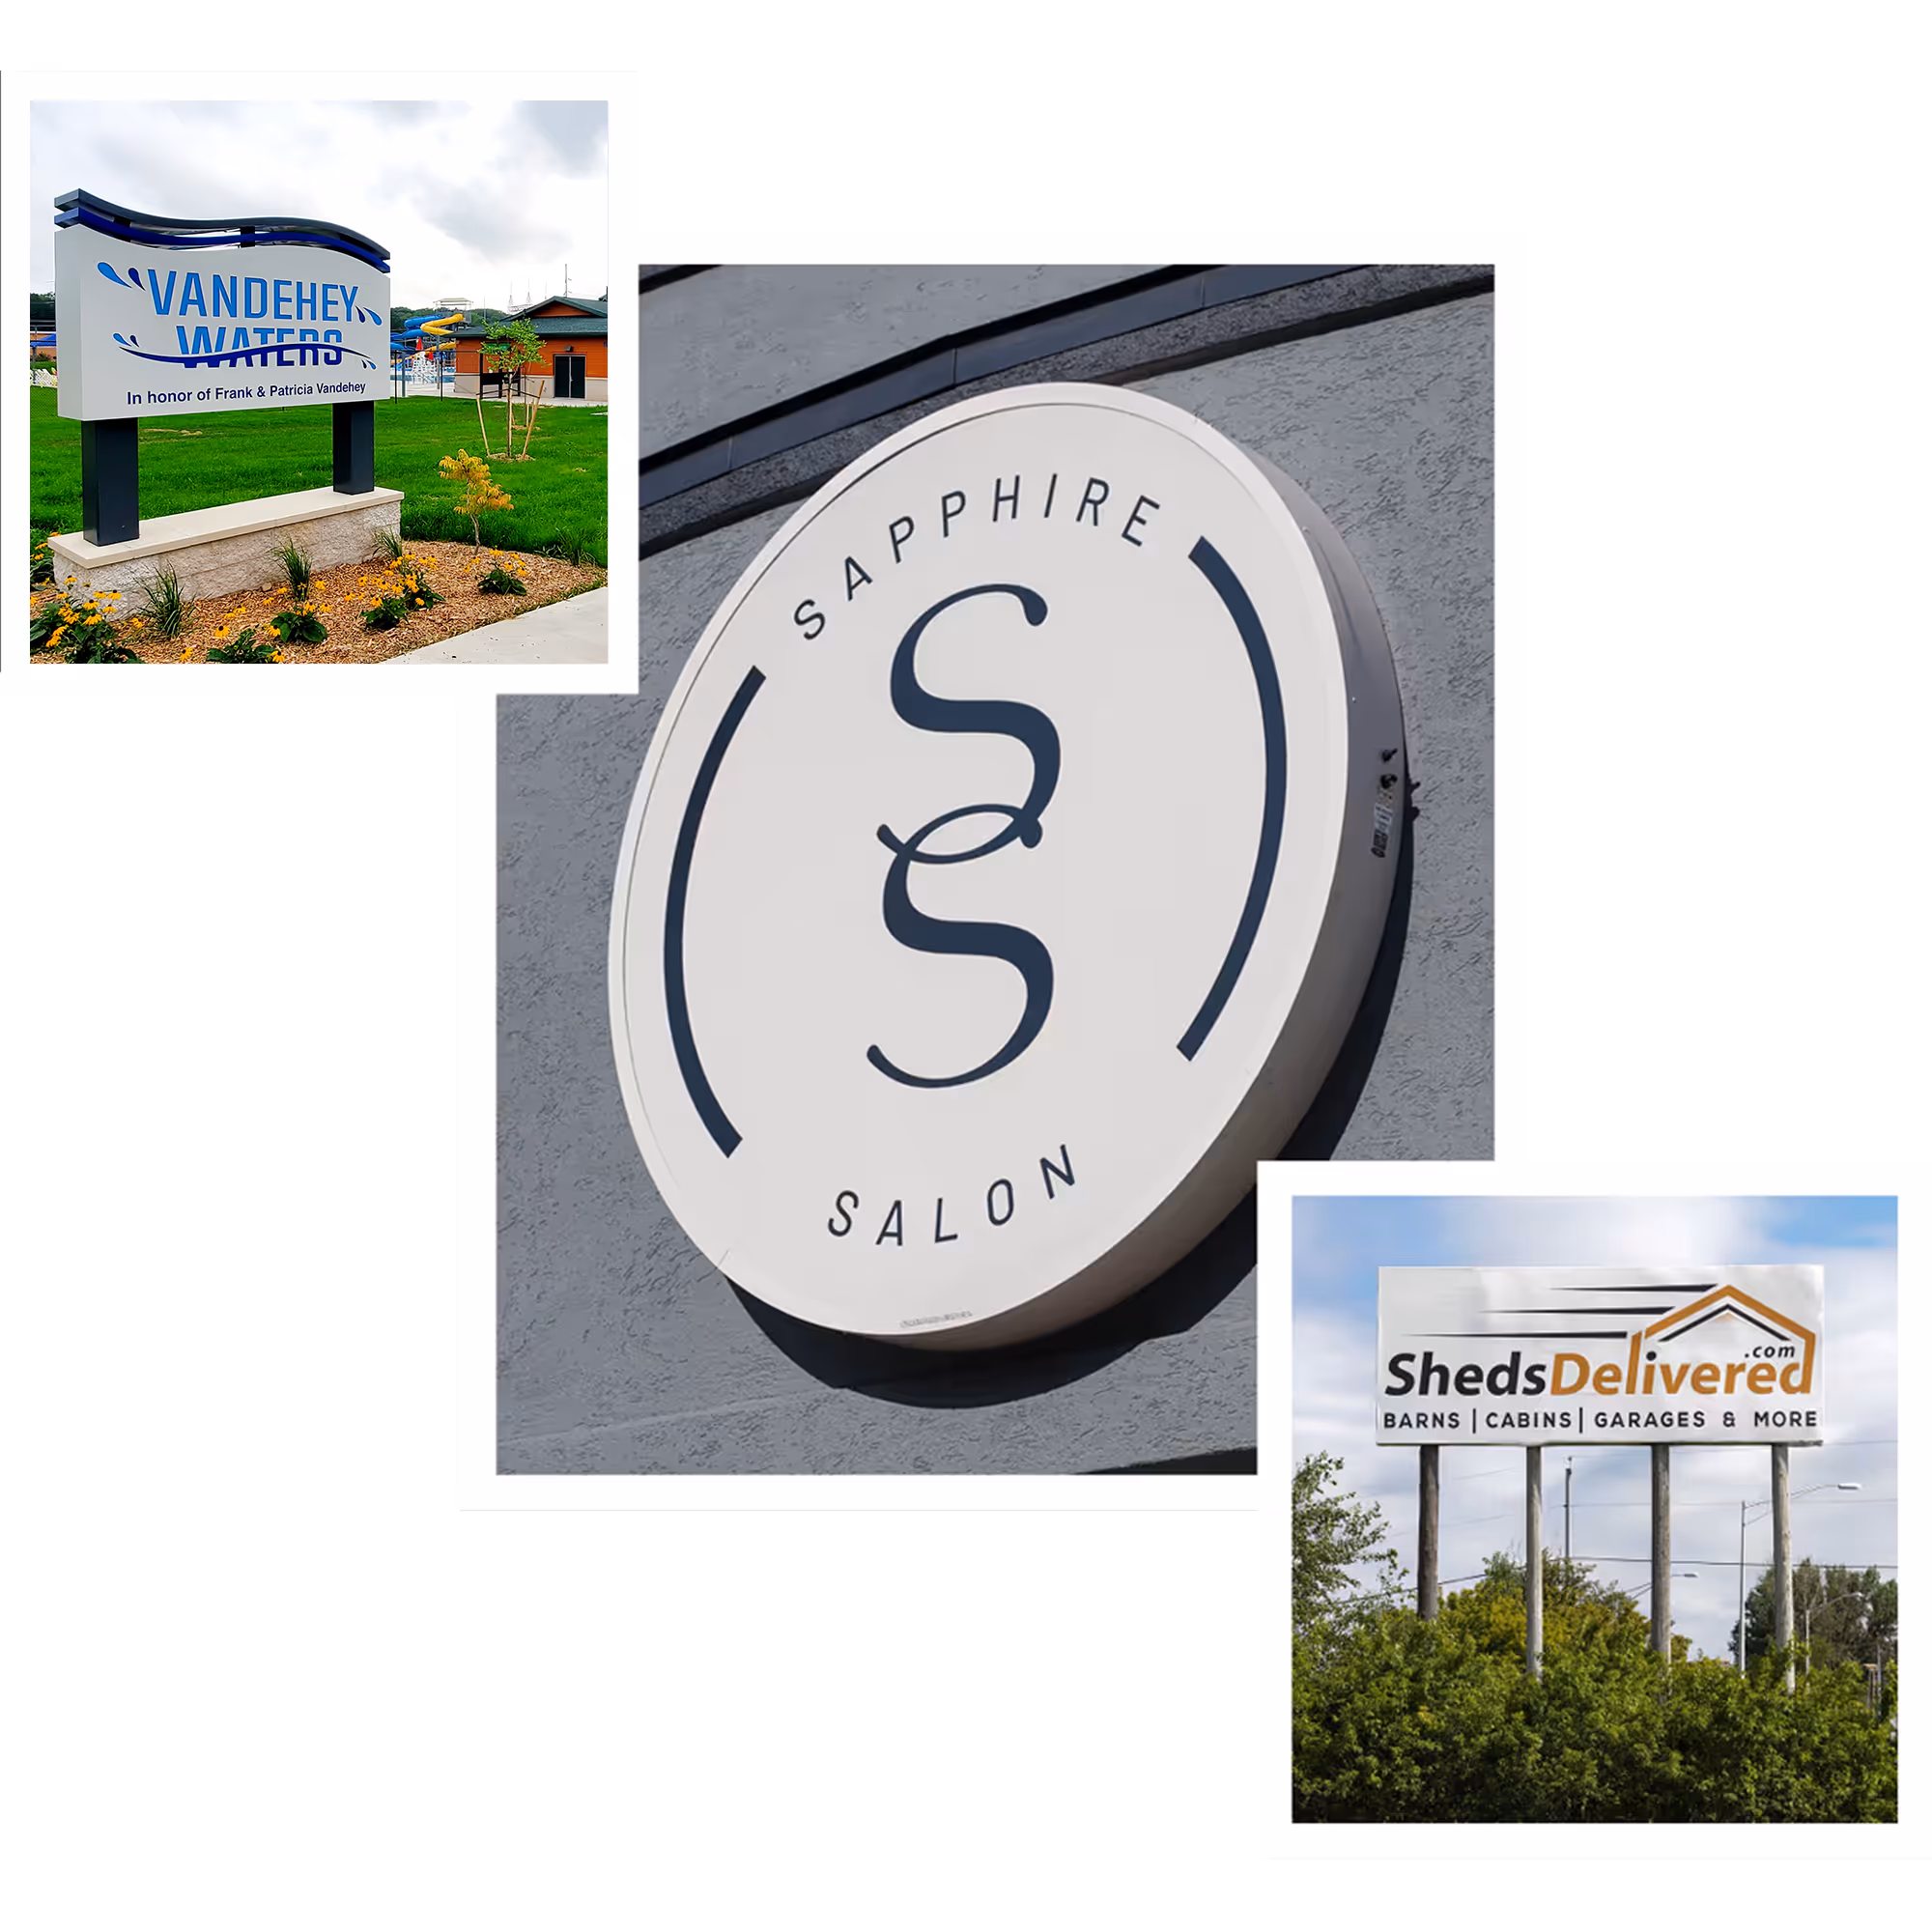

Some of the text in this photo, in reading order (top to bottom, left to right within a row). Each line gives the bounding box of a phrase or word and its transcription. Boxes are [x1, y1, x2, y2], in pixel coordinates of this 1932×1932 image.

[147, 269, 358, 323] VANDEHEY
[175, 326, 342, 368] WATERS
[128, 382, 366, 405] In honor of Frank & Patricia Vandehey
[793, 472, 1160, 640] SAPPHIRE
[828, 1144, 1075, 1246] SALON
[1745, 1343, 1796, 1358] .com
[1383, 1411, 1818, 1430] BARNS CABINS GARAGES & MORE
